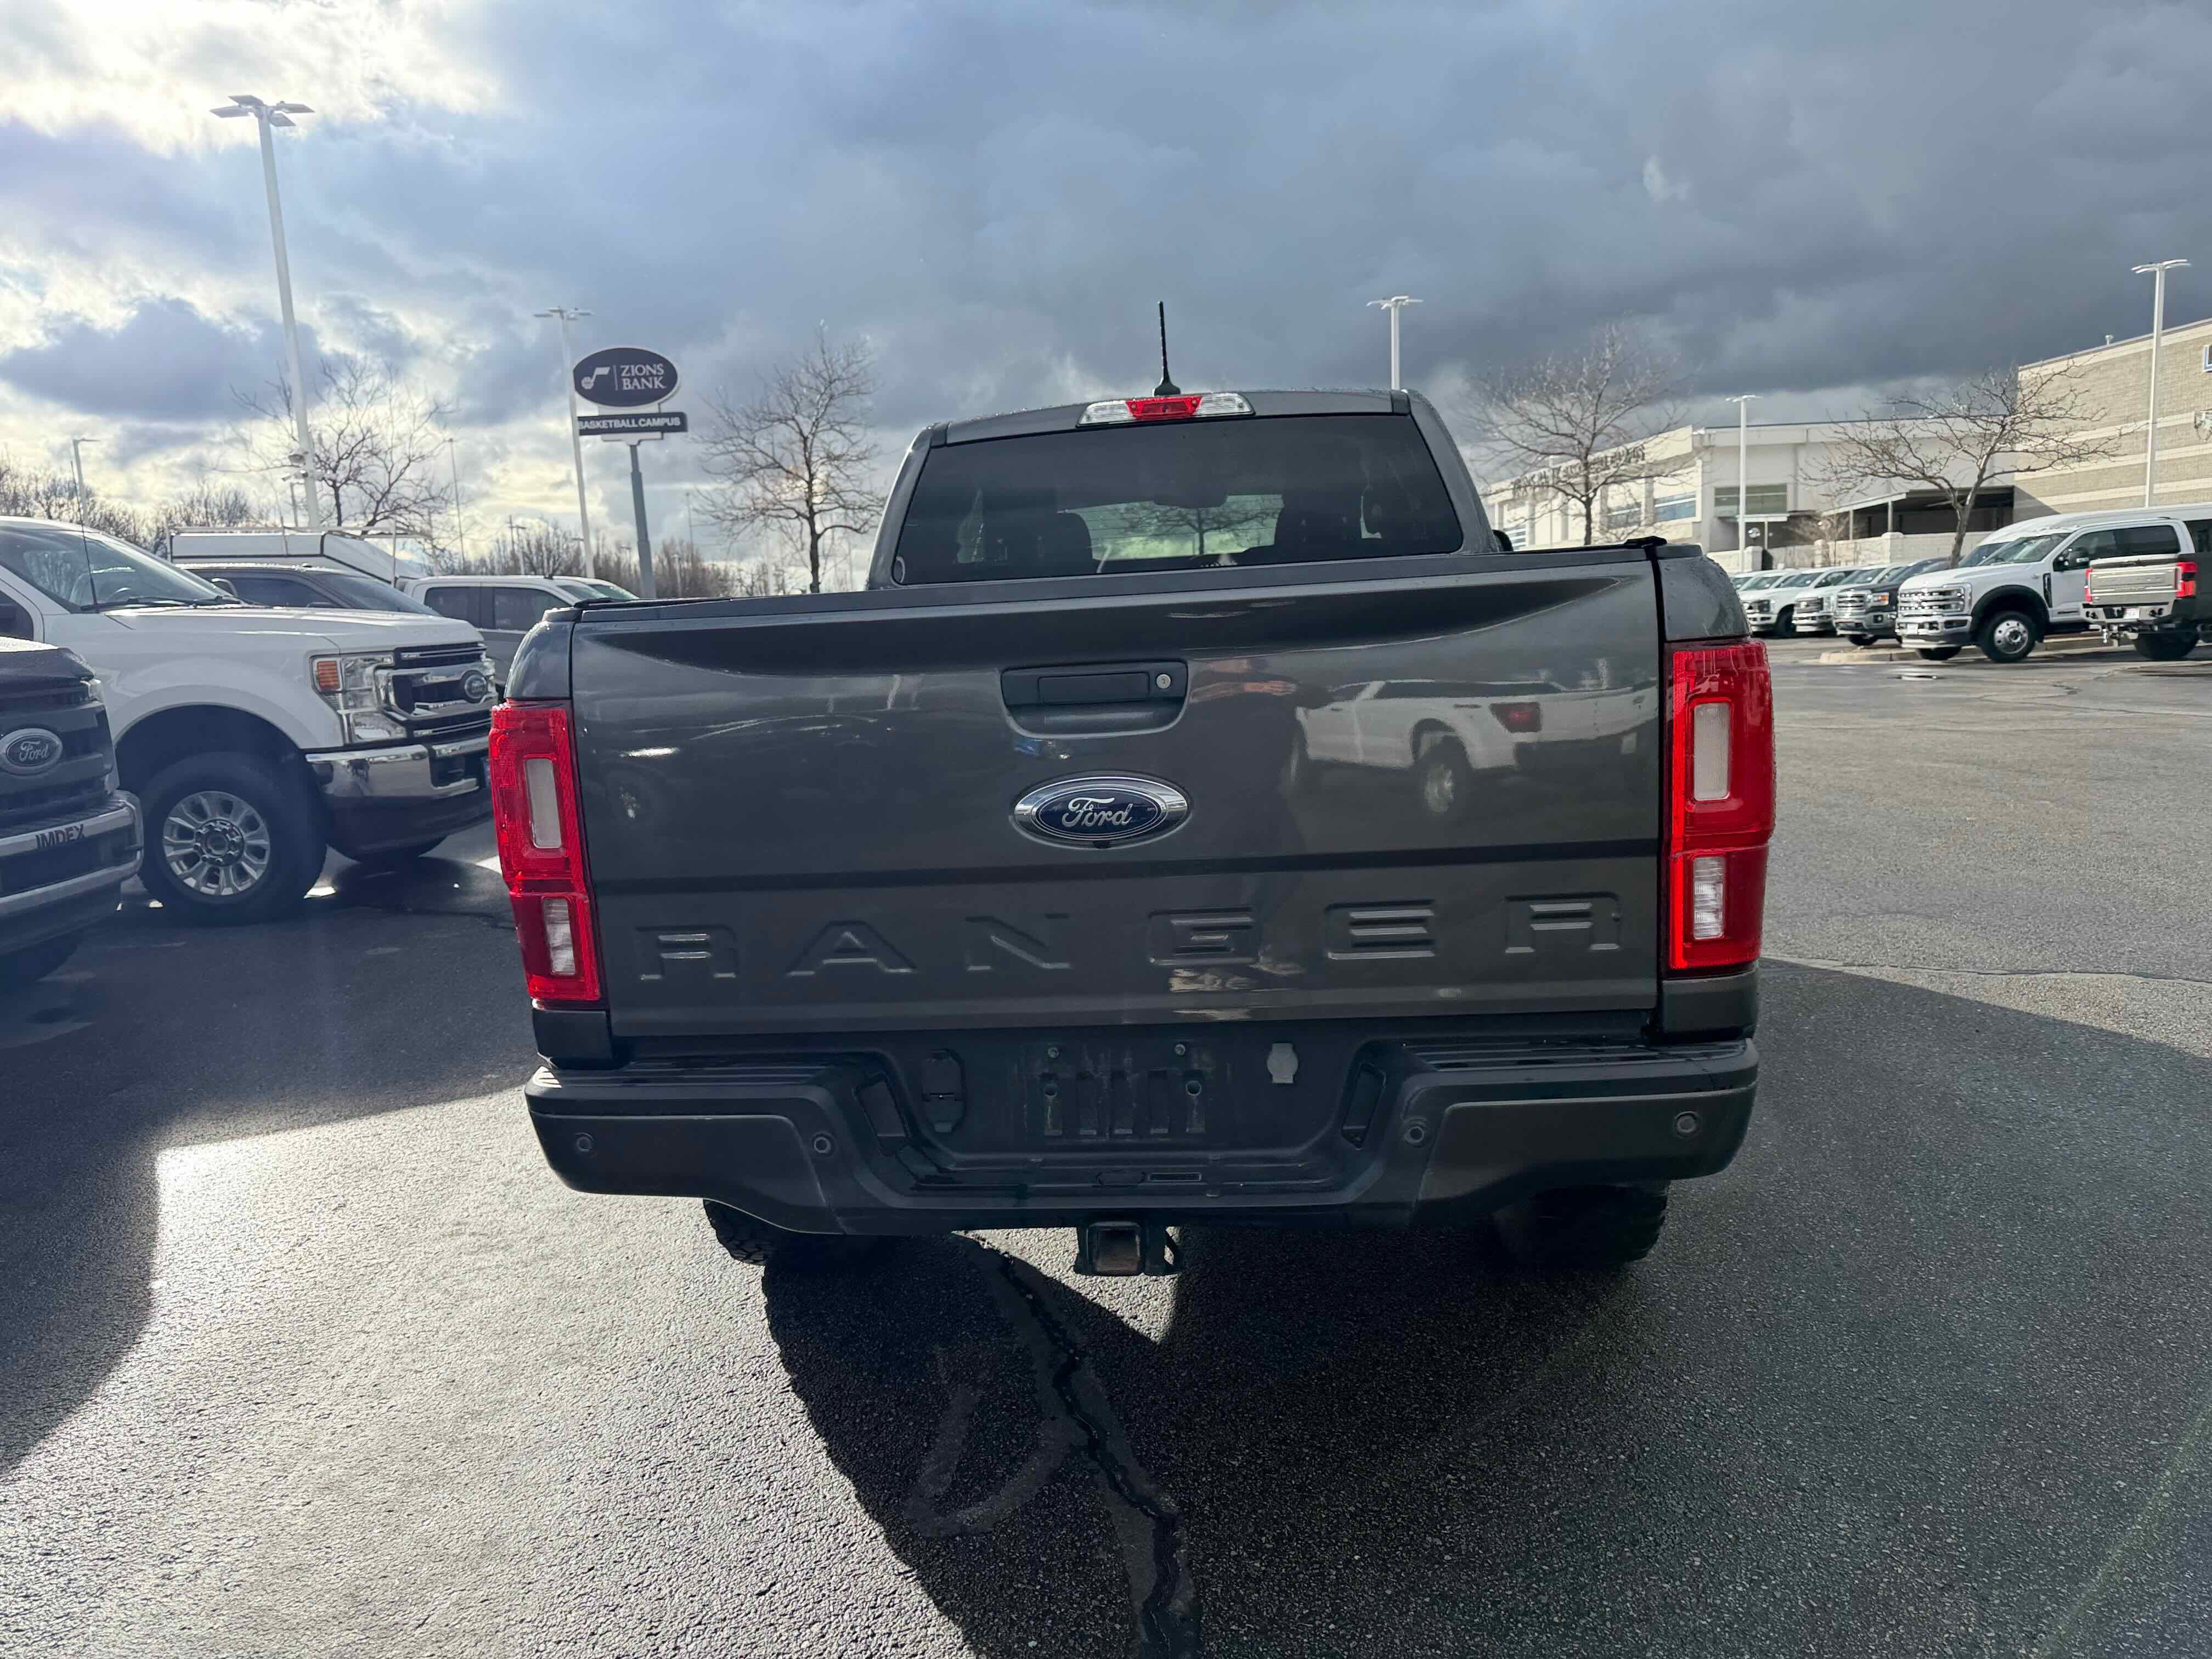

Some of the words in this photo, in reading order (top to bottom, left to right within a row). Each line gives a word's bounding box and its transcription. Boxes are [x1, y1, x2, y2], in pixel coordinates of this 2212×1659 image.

[620, 363, 664, 377] ZIONS
[622, 376, 667, 390] BANK
[578, 419, 638, 430] BASKETBALL
[638, 417, 681, 427] CAMPUS
[19, 741, 49, 762] Ford
[1062, 797, 1133, 827] Ford
[35, 824, 85, 850] IMDEX
[635, 891, 1622, 980] RANGER
